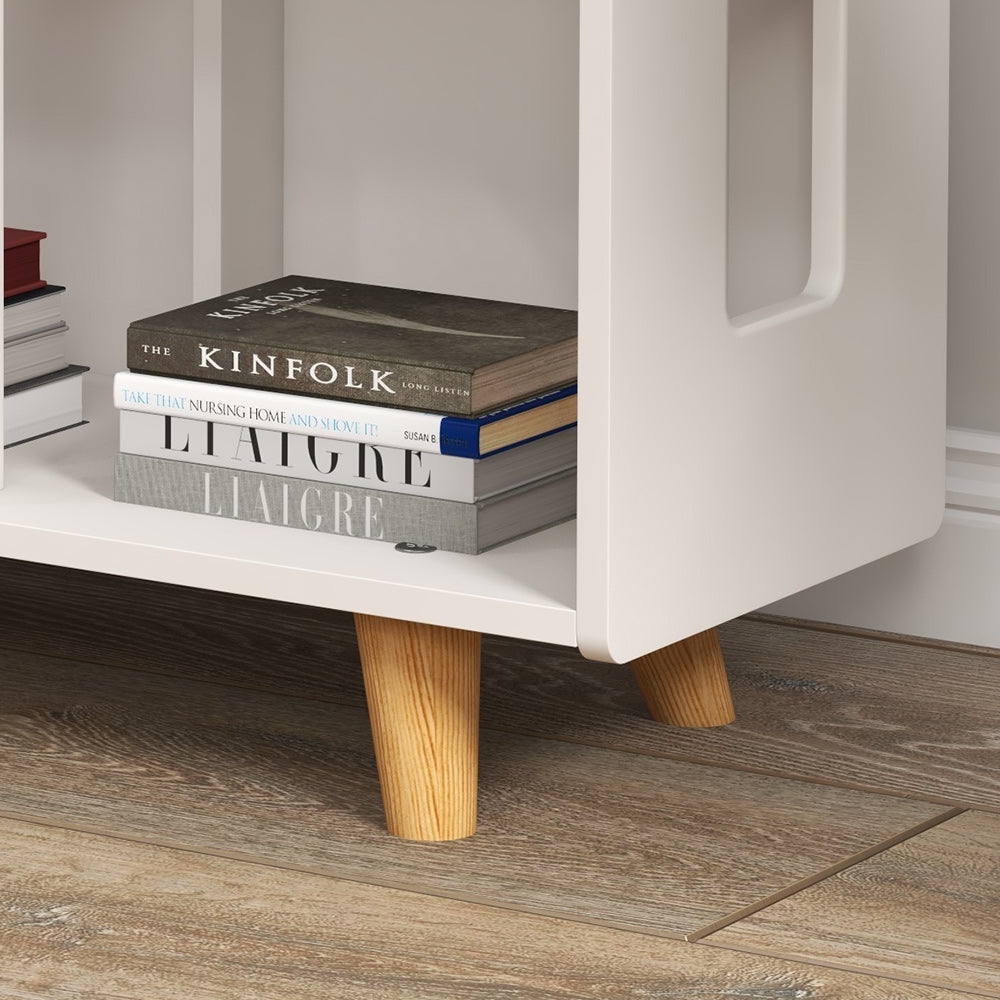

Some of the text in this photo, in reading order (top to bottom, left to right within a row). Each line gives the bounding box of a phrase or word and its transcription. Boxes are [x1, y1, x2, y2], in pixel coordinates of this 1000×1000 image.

[206, 287, 325, 319] KINFOLK
[141, 344, 471, 397] THE KINFOLK LONG LISTEN
[122, 388, 151, 405] TAKE
[153, 393, 187, 410] THAT
[189, 399, 246, 419] NURSING
[248, 406, 287, 425] HOME
[289, 413, 318, 428] AND
[320, 416, 360, 434] SHOVE
[403, 430, 430, 443] SUSAN
[204, 472, 385, 540] LIAIGRE
